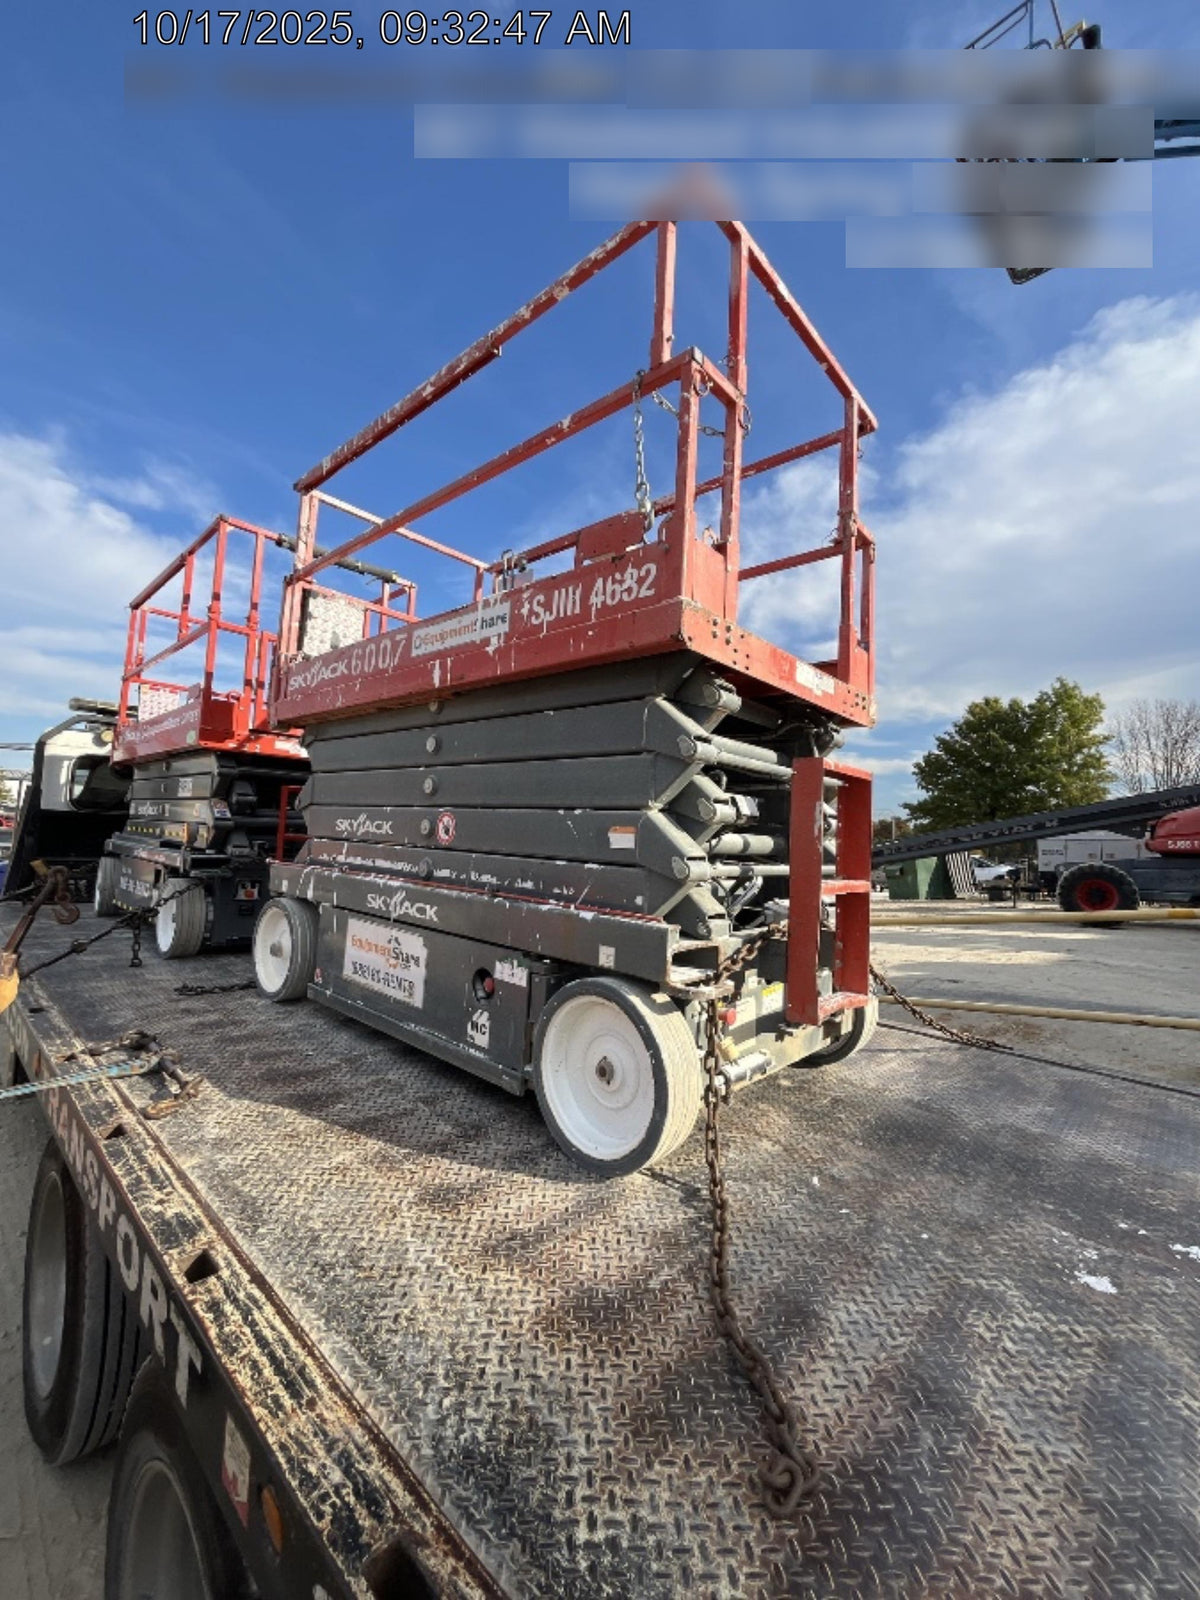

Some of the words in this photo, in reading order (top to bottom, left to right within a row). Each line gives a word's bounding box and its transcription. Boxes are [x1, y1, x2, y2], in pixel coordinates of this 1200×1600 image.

[589, 563, 657, 609] 4632
[288, 659, 349, 690] SKYJACK
[335, 812, 393, 836] SKYJACK
[367, 889, 439, 921] SKYJACK
